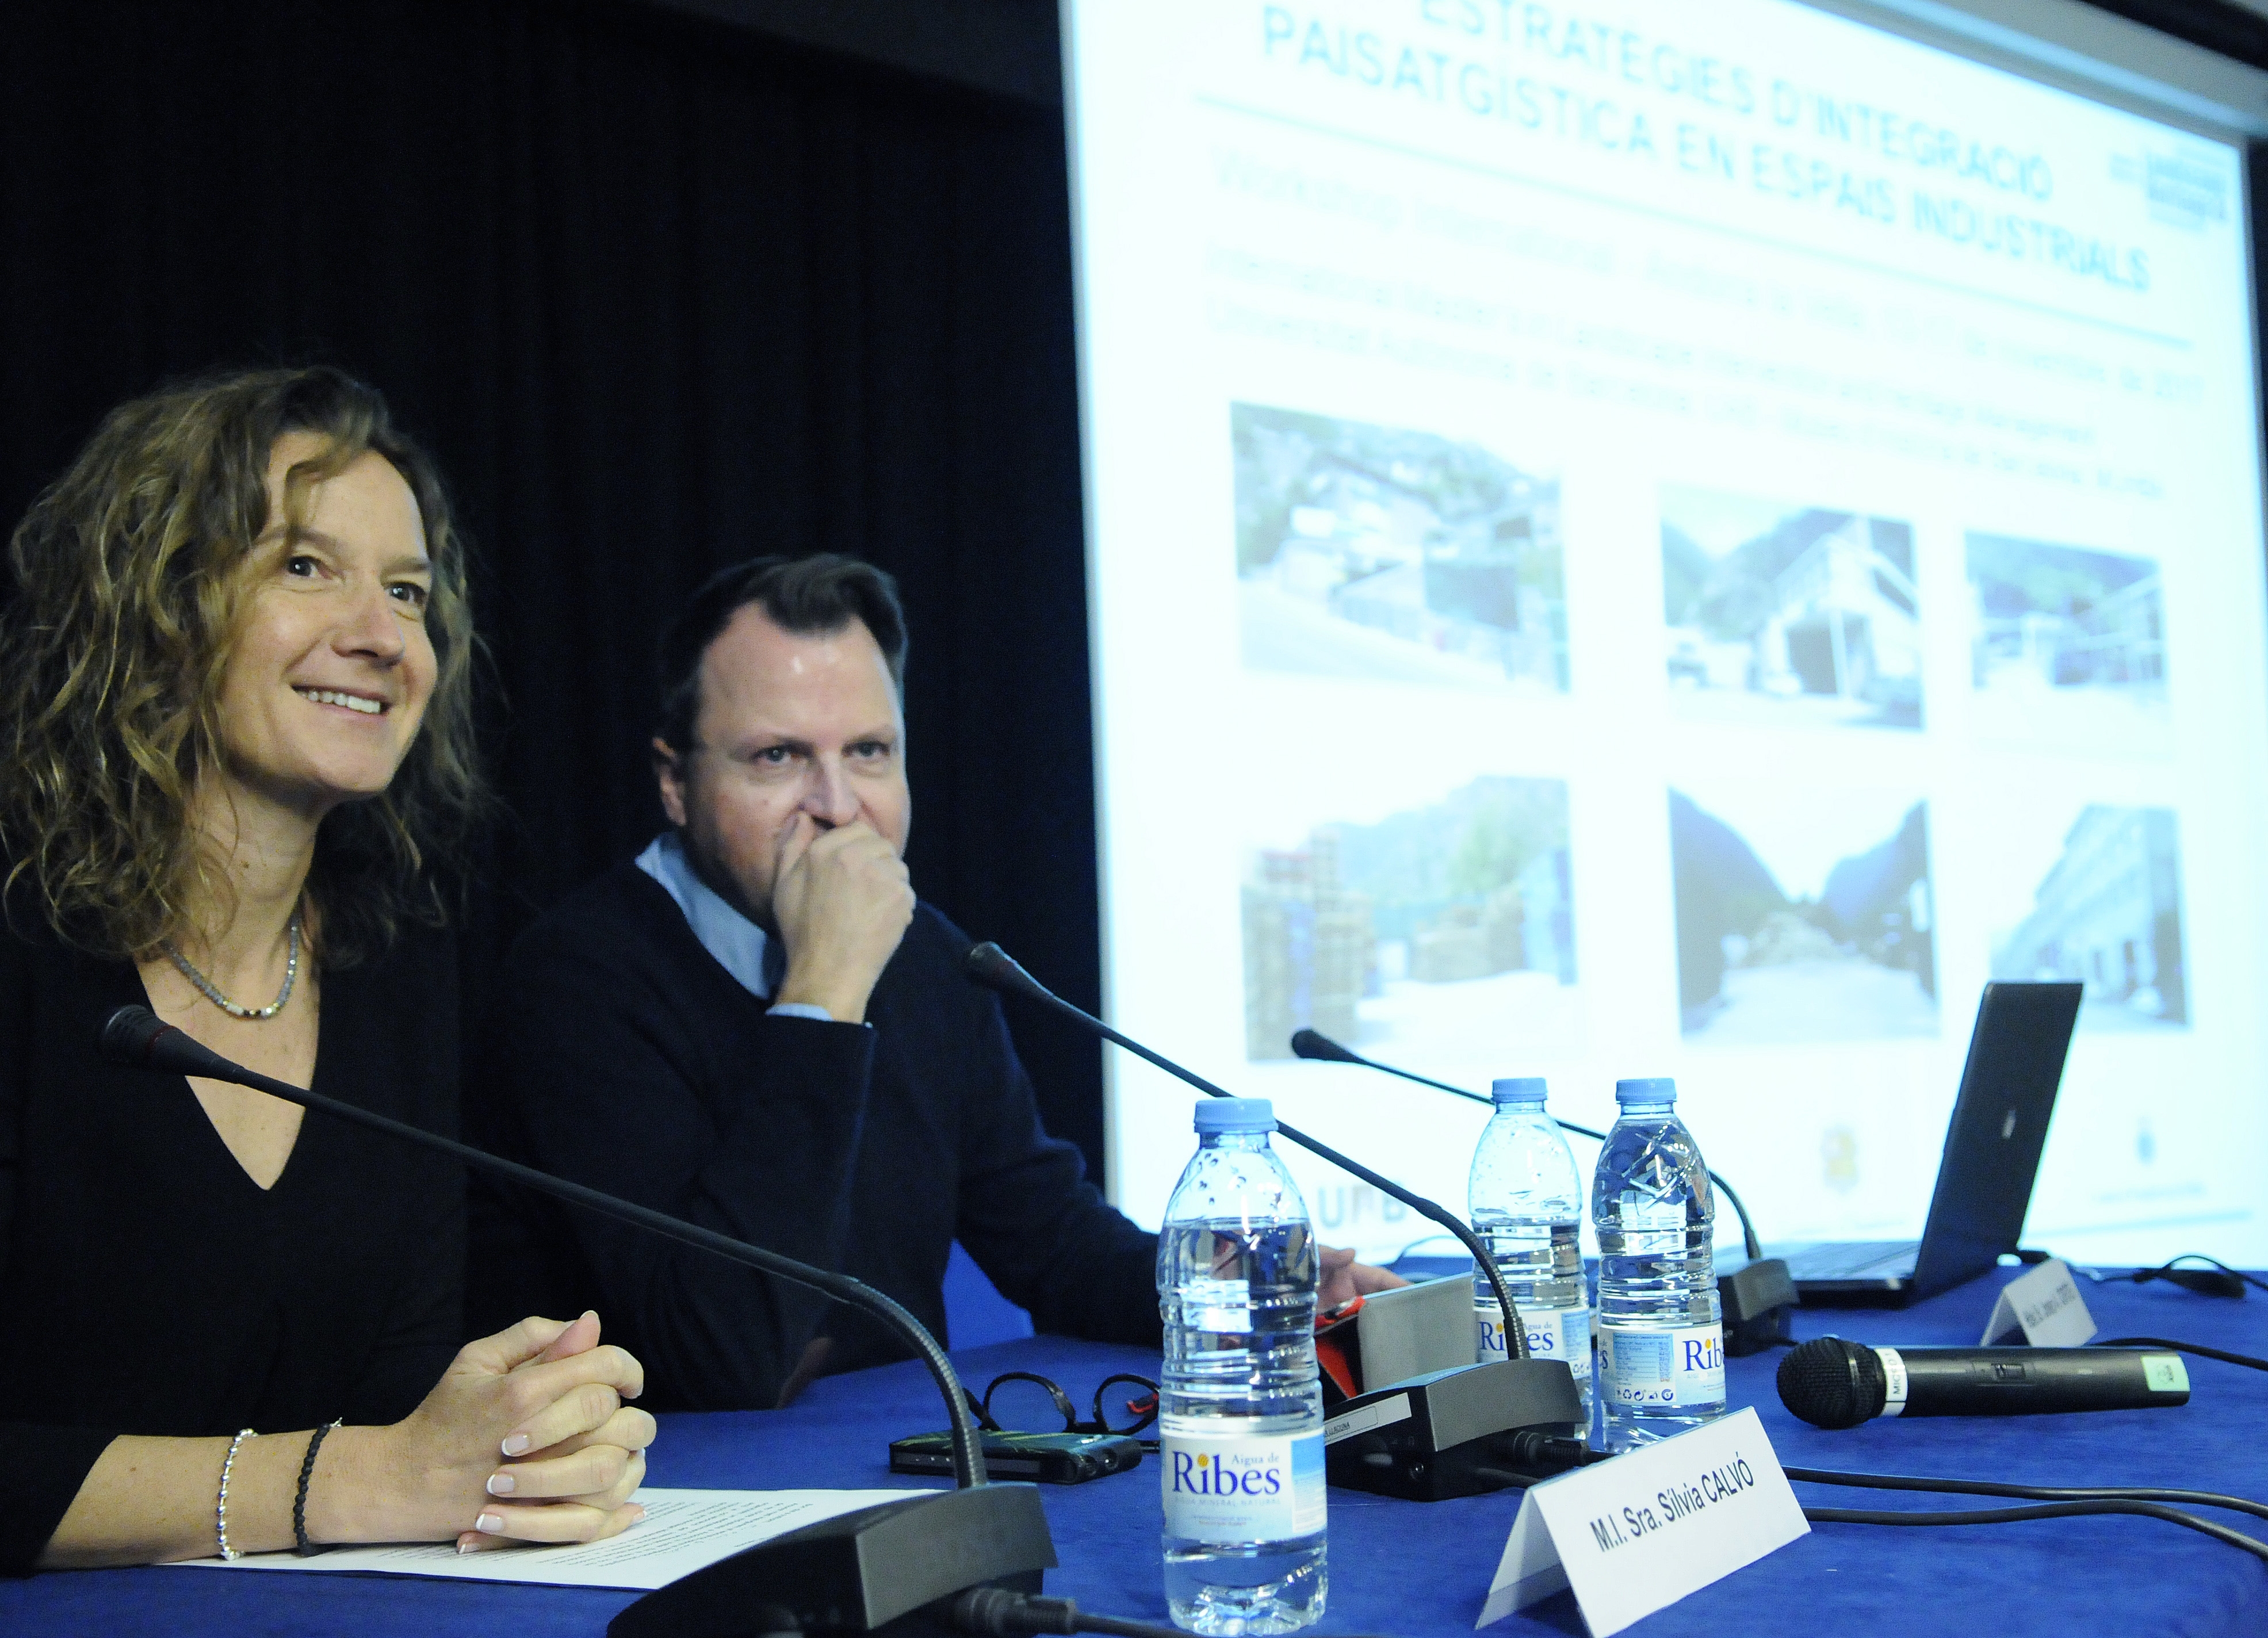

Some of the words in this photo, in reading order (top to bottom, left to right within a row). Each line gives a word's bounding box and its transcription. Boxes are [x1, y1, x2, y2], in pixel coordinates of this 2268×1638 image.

[1676, 121, 1736, 182] EN
[1751, 142, 1897, 225] ESPAIS
[1911, 189, 2151, 293] INDUSTRIALS
[1479, 1321, 1554, 1352] Ries
[1682, 1337, 1723, 1372] Rib
[1173, 1450, 1280, 1497] Ribes
[1231, 1454, 1264, 1467] Aigua
[1267, 1452, 1280, 1463] de
[1589, 1514, 1628, 1552] M.I.
[1623, 1506, 1663, 1538] Sra.
[1657, 1482, 1706, 1522] Sílvia
[1701, 1451, 1754, 1503] CALVÓ
